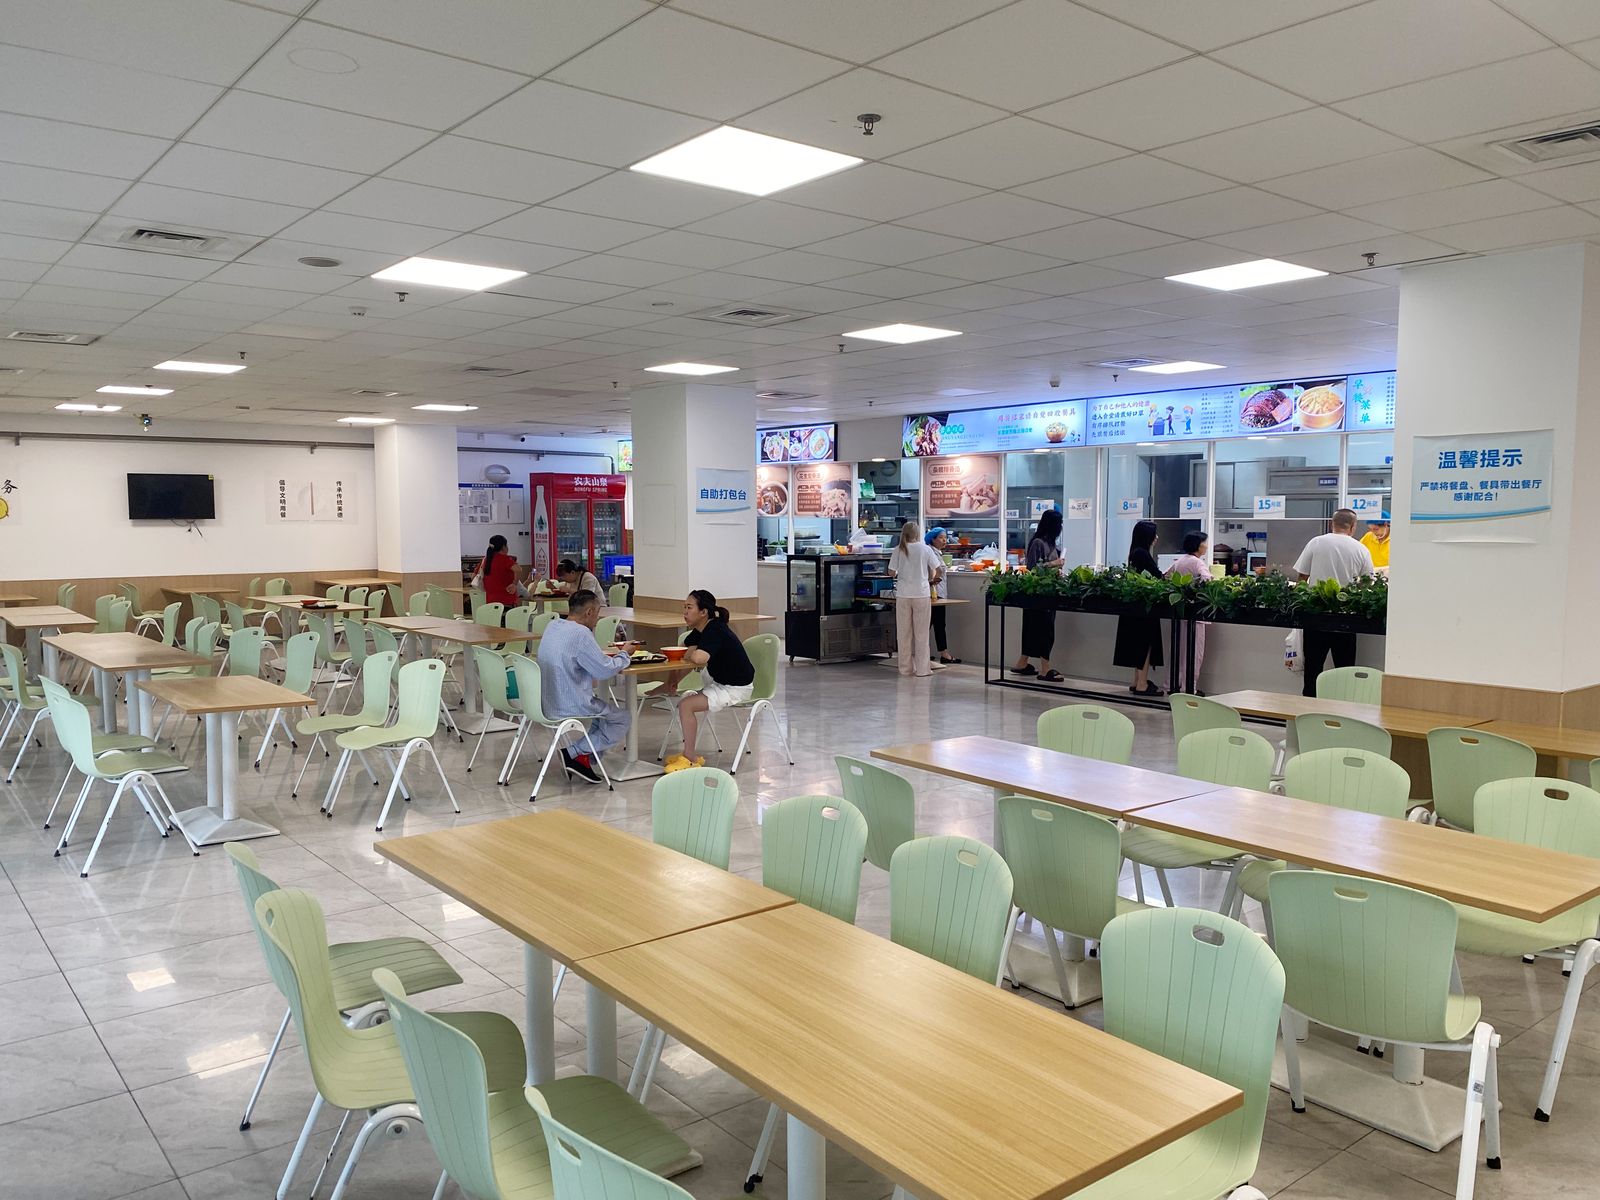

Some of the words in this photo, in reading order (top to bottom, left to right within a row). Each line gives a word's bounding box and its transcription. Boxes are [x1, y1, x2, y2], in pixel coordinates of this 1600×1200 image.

[1438, 448, 1523, 469] 温馨提示
[574, 476, 608, 487] 农夫山泉
[1420, 479, 1543, 491] 严禁将餐盘、餐具带出餐厅
[700, 488, 747, 500] 自助打包台
